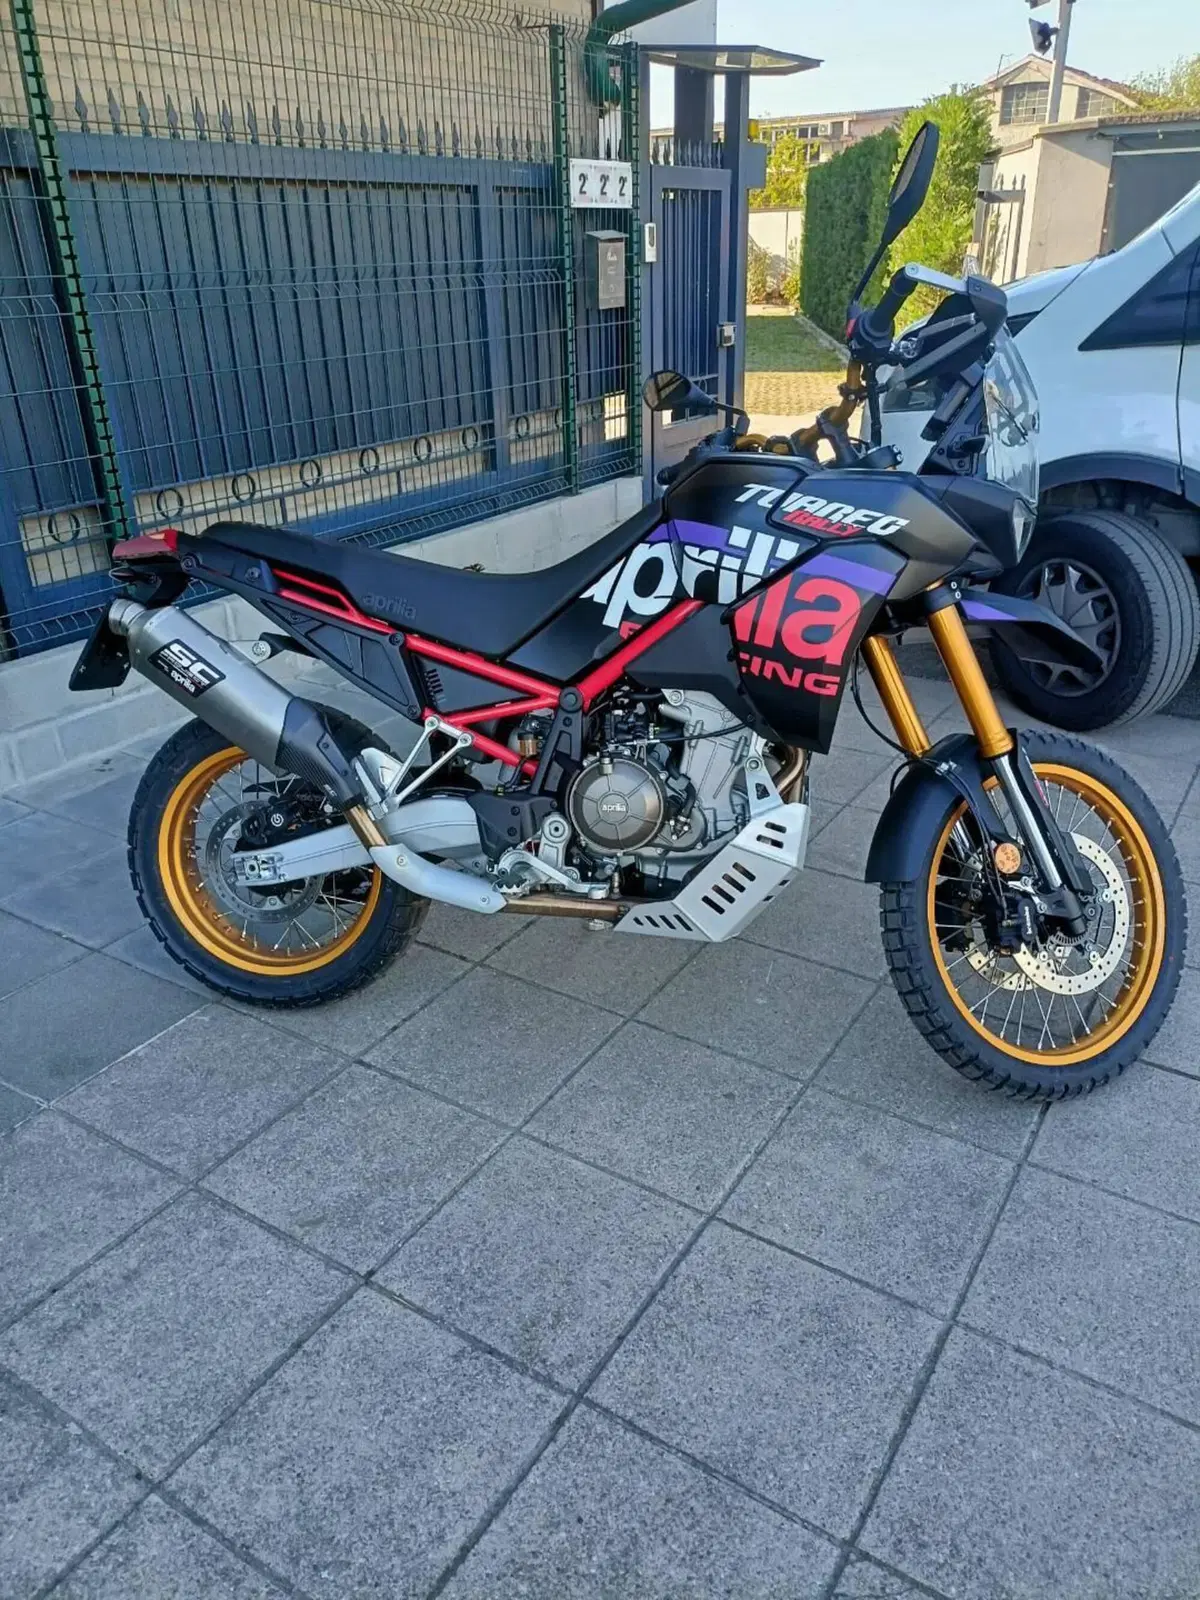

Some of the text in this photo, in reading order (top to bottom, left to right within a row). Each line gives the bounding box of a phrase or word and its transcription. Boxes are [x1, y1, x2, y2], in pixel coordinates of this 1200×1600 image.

[735, 483, 911, 536] TUAREG
[783, 510, 861, 538] RALLY
[362, 592, 417, 620] aprilia
[164, 643, 220, 684] SC
[170, 669, 196, 693] aprilia
[601, 802, 626, 813] aprilia
